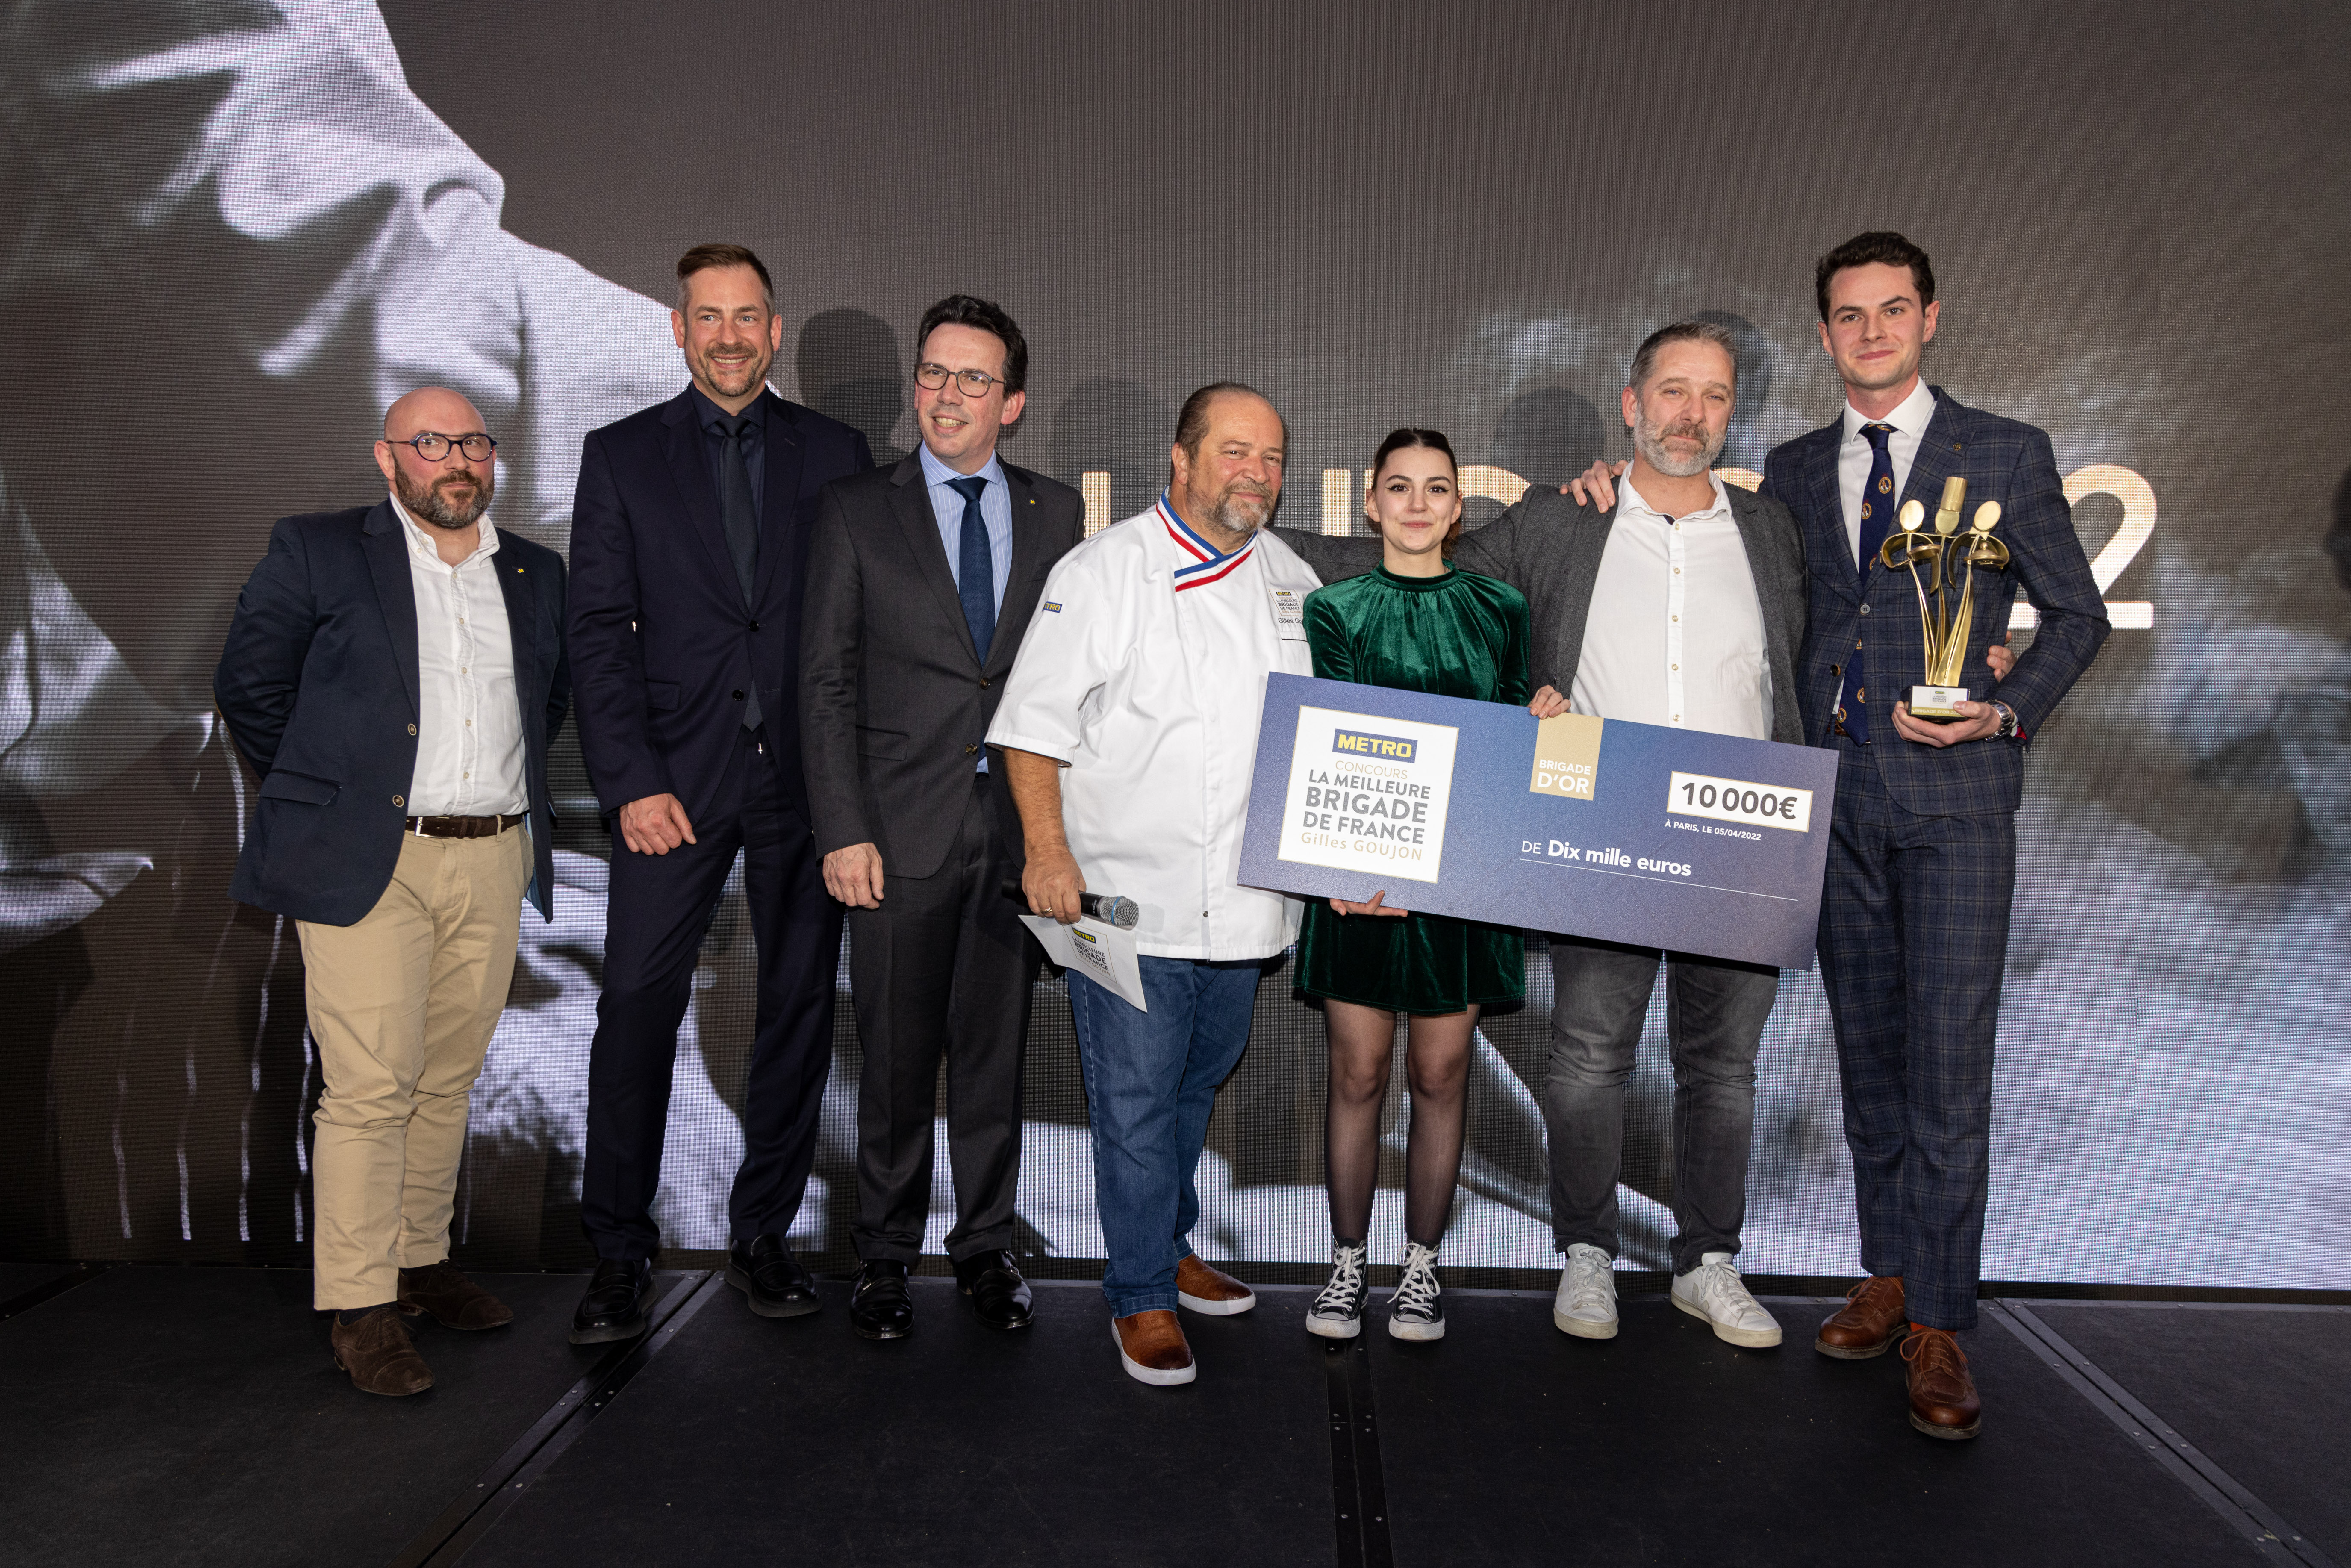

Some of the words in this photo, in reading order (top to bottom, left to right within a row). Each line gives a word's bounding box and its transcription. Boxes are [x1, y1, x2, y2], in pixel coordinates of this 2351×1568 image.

[1338, 734, 1412, 757] METRO
[1335, 760, 1408, 779] CONCOURS
[1539, 759, 1591, 775] BRIGADE
[1309, 769, 1329, 785] LA
[1334, 773, 1431, 799] MEILLEURE
[1537, 772, 1589, 794] D'OR
[1305, 787, 1428, 823] BRIGADE
[1682, 782, 1716, 808] 10
[1722, 787, 1798, 819] 000€
[1303, 811, 1332, 830] DE
[1338, 816, 1424, 844] FRANCE
[1665, 819, 1671, 828] À
[1673, 822, 1699, 833] PARIS,
[1714, 827, 1762, 840] 05/04/2022
[1301, 832, 1346, 849] Gilles
[1354, 840, 1422, 860] GOUJON
[1521, 841, 1541, 854] DE
[1548, 839, 1580, 860] Dix
[1585, 846, 1631, 867] mille
[1636, 857, 1691, 876] euros
[1073, 928, 1095, 942] METRO
[1074, 941, 1107, 965] BRIGADE
[1077, 948, 1084, 956] DE
[1085, 954, 1109, 971] FRANCE
[1078, 941, 1105, 957] MEILLEURE
[1092, 963, 1110, 976] GOUJON
